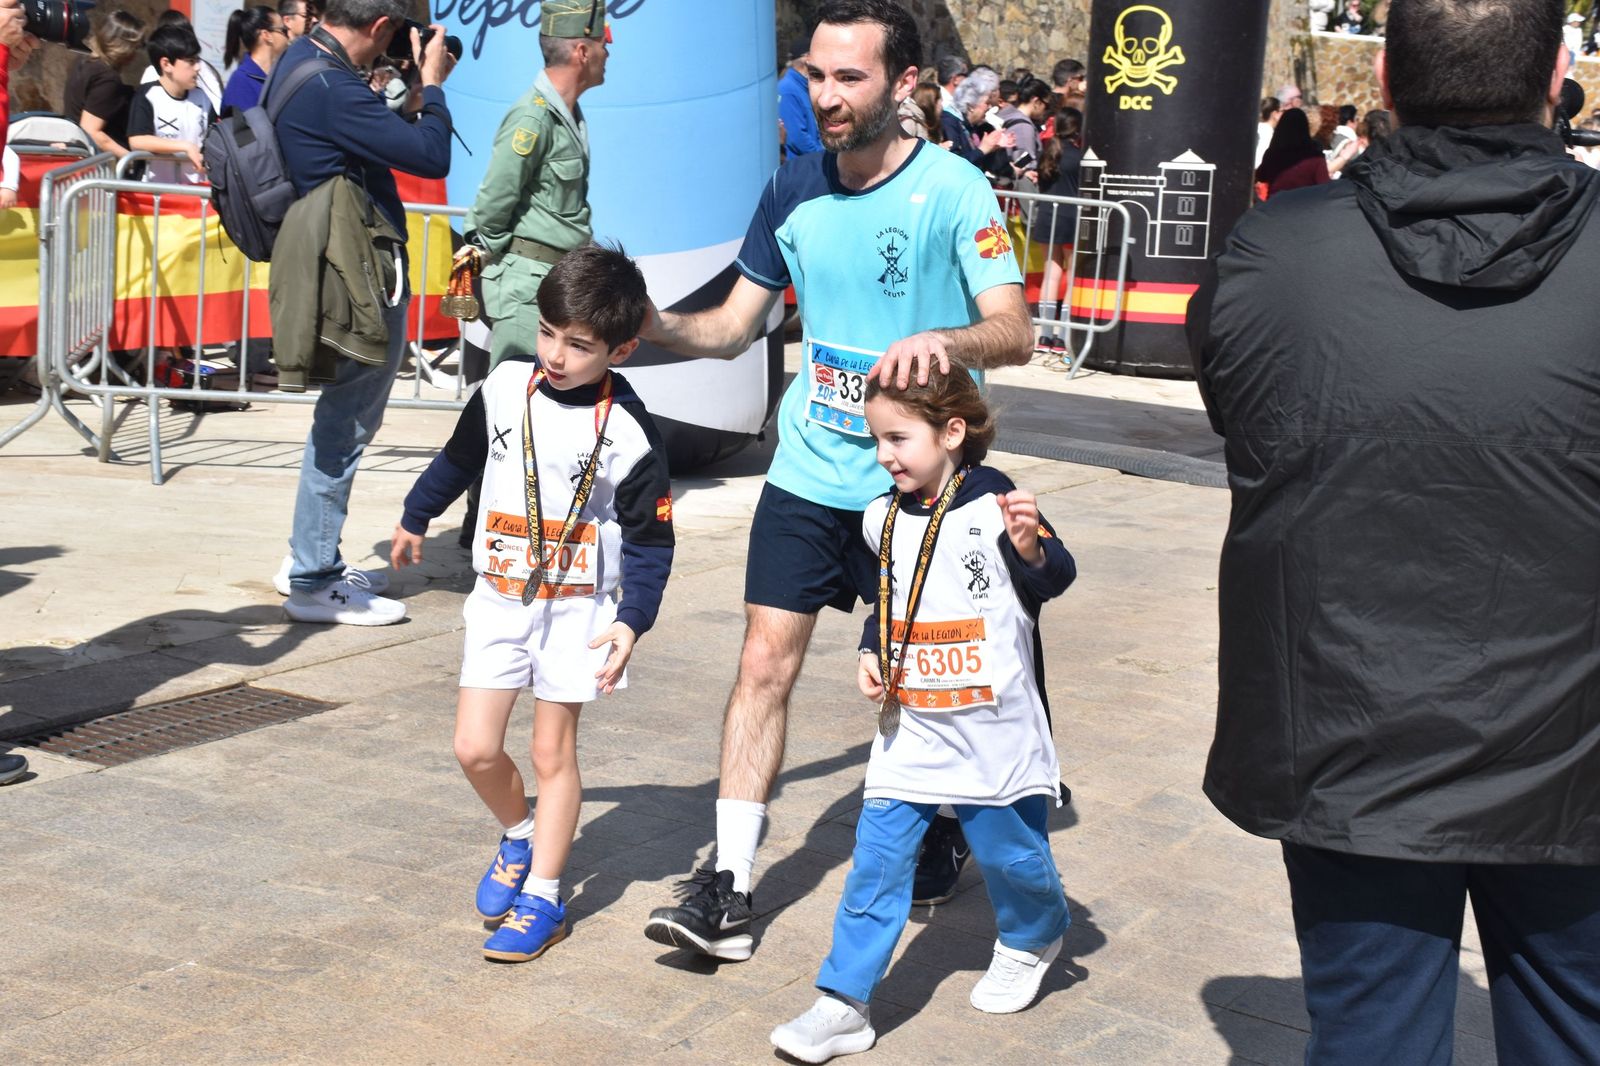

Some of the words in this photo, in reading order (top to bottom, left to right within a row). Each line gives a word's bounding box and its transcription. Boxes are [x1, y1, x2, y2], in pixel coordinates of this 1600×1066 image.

[1119, 95, 1153, 111] DCC
[876, 230, 885, 240] LA
[883, 289, 906, 298] CEUTA
[814, 347, 823, 360] X
[838, 371, 864, 403] 33
[492, 516, 502, 529] X
[498, 543, 524, 552] DONCEL
[526, 542, 589, 573] 6304
[931, 628, 962, 640] LEGION
[917, 646, 982, 677] 6305
